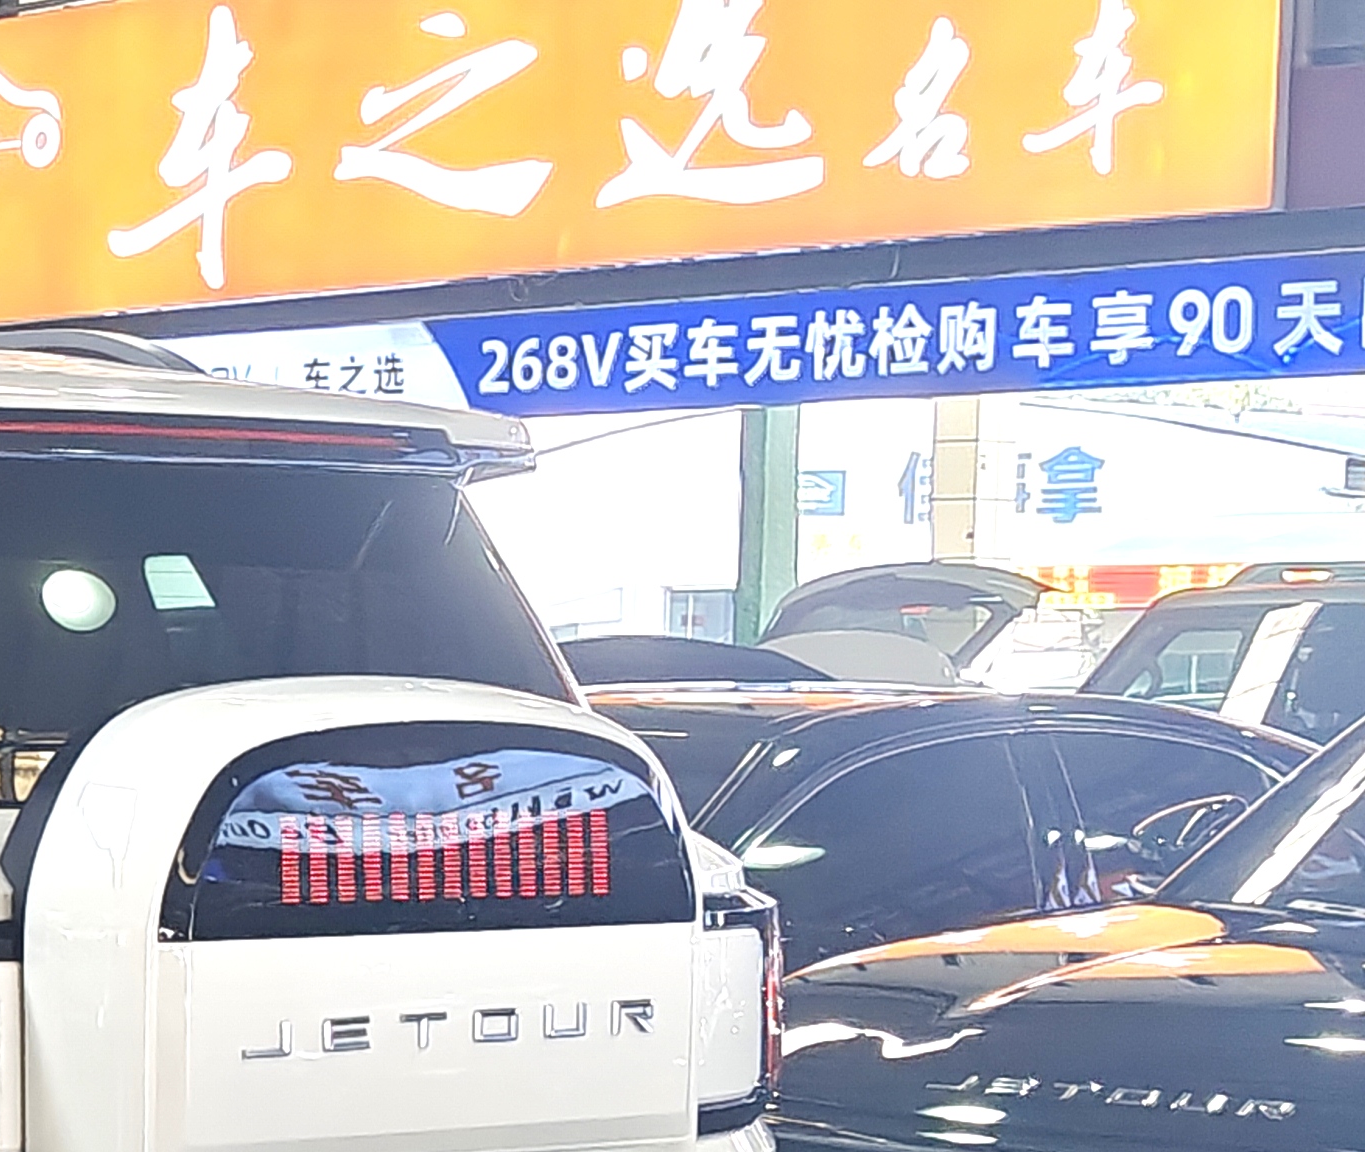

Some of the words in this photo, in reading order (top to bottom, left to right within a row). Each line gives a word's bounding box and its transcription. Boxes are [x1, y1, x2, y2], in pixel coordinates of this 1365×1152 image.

[106, 0, 1164, 290] 车之选名车
[303, 353, 405, 394] 车之选
[241, 998, 658, 1060] JETOUR
[924, 1073, 1297, 1120] JETOUR
